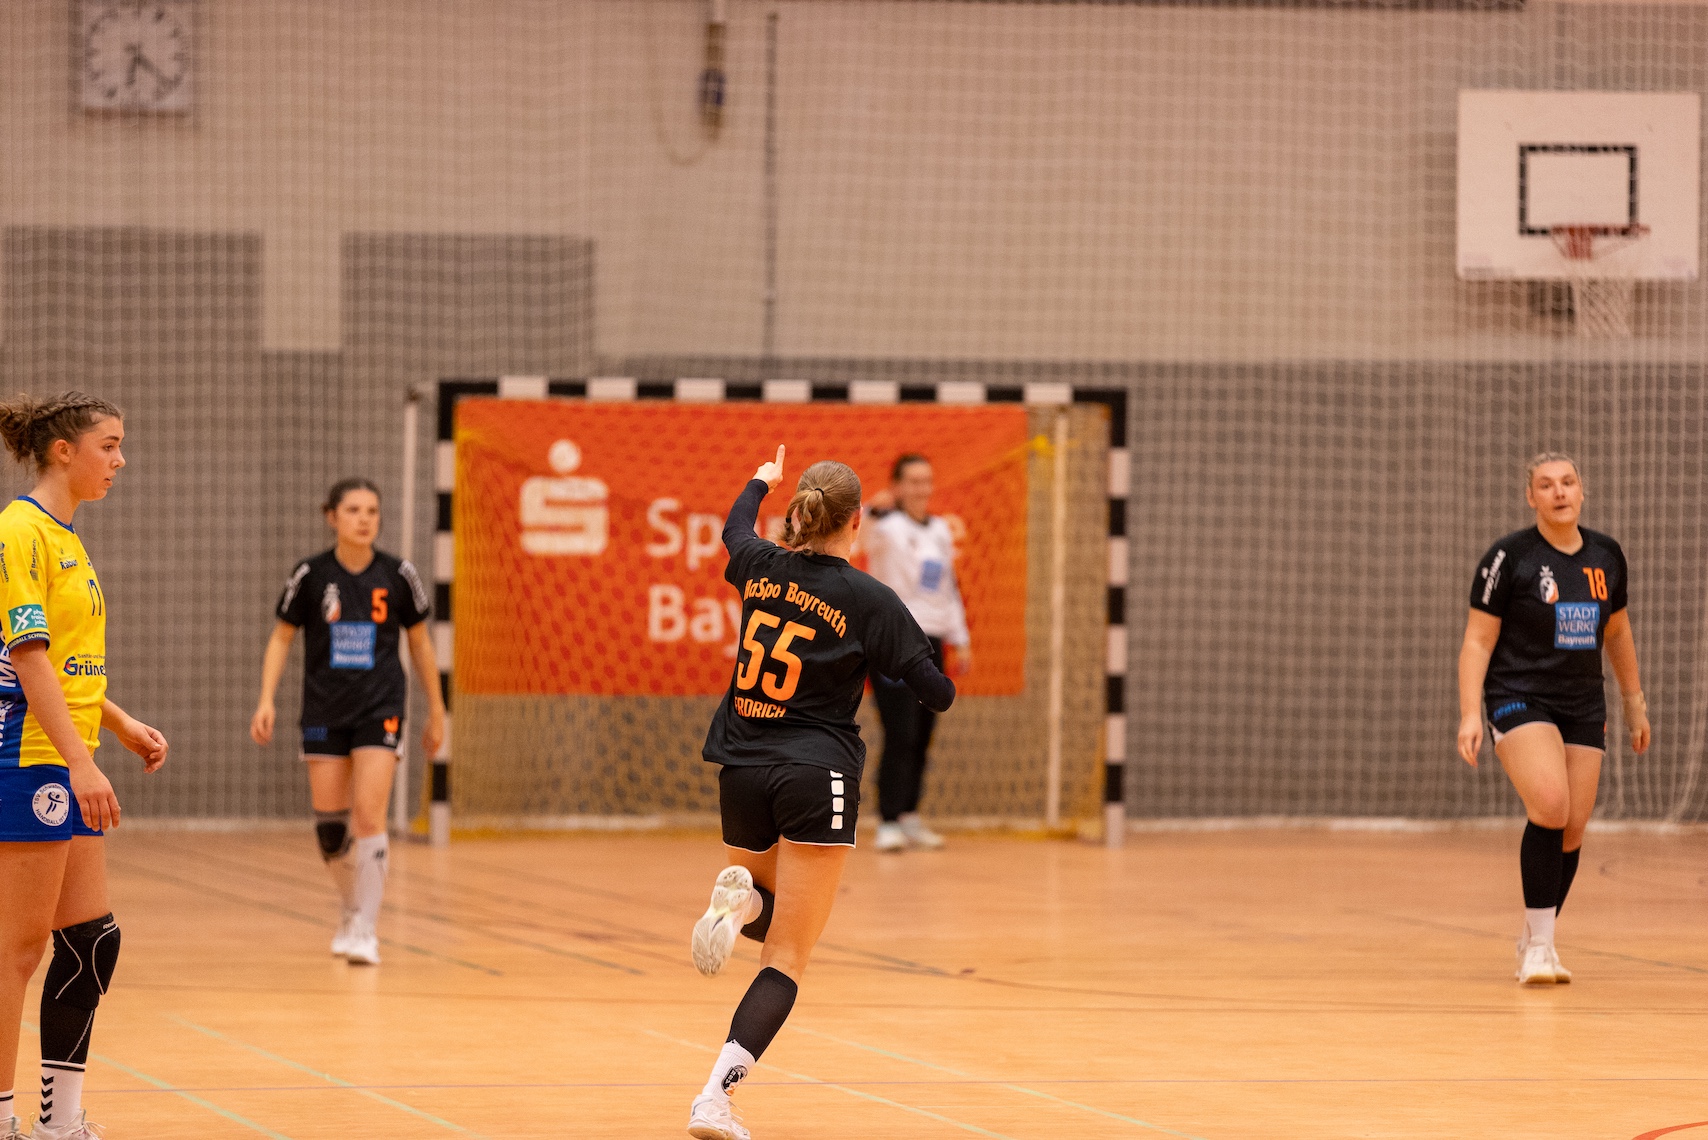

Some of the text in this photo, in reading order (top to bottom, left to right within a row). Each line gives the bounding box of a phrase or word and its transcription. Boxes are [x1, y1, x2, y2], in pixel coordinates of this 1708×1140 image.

[1582, 567, 1608, 601] 18
[371, 587, 389, 624] 5
[743, 577, 847, 639] HaSpo Bayreuth
[1558, 606, 1598, 621] STADT
[1557, 634, 1597, 647] Bayreuth
[1558, 620, 1597, 634] WERKE
[736, 609, 817, 702] 55
